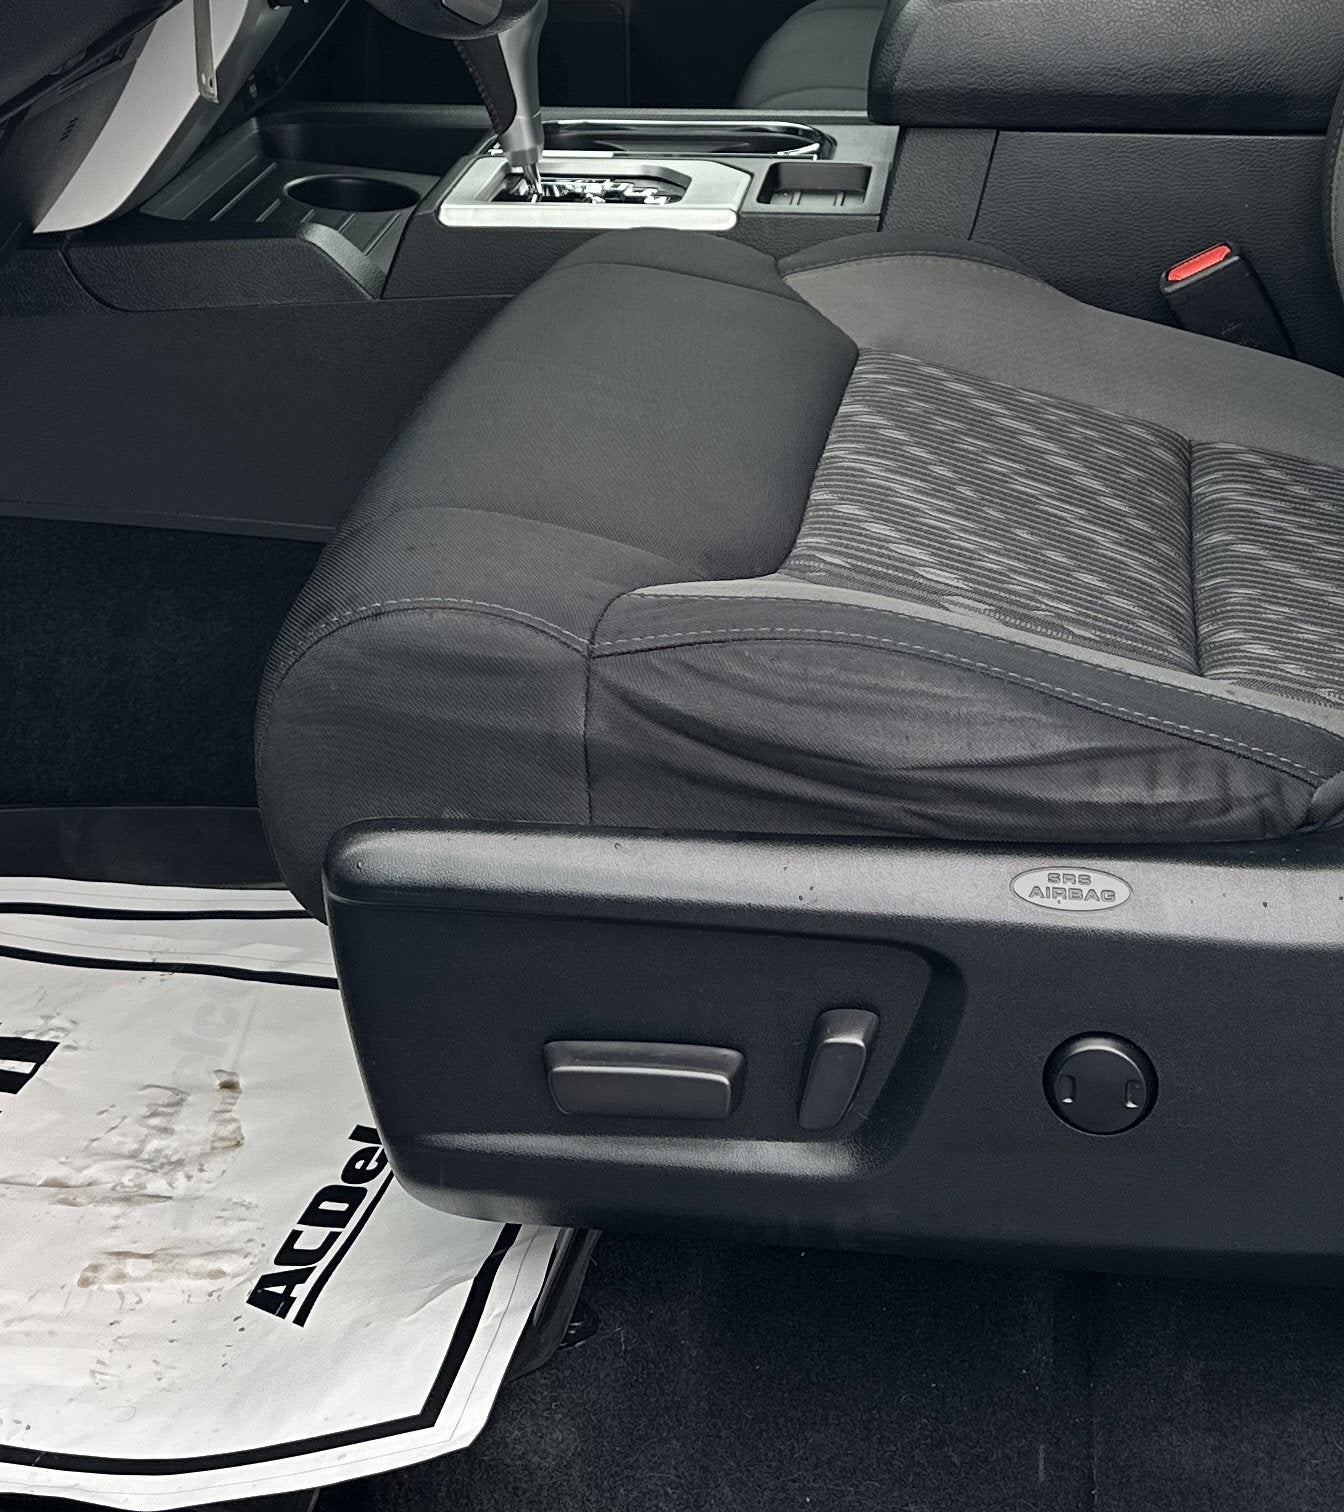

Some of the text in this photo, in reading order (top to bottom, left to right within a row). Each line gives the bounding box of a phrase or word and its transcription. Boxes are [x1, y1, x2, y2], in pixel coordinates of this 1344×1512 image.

[1047, 872, 1092, 886] SRS
[1028, 885, 1116, 903] AIRBAG
[246, 1124, 389, 1320] ACDel
